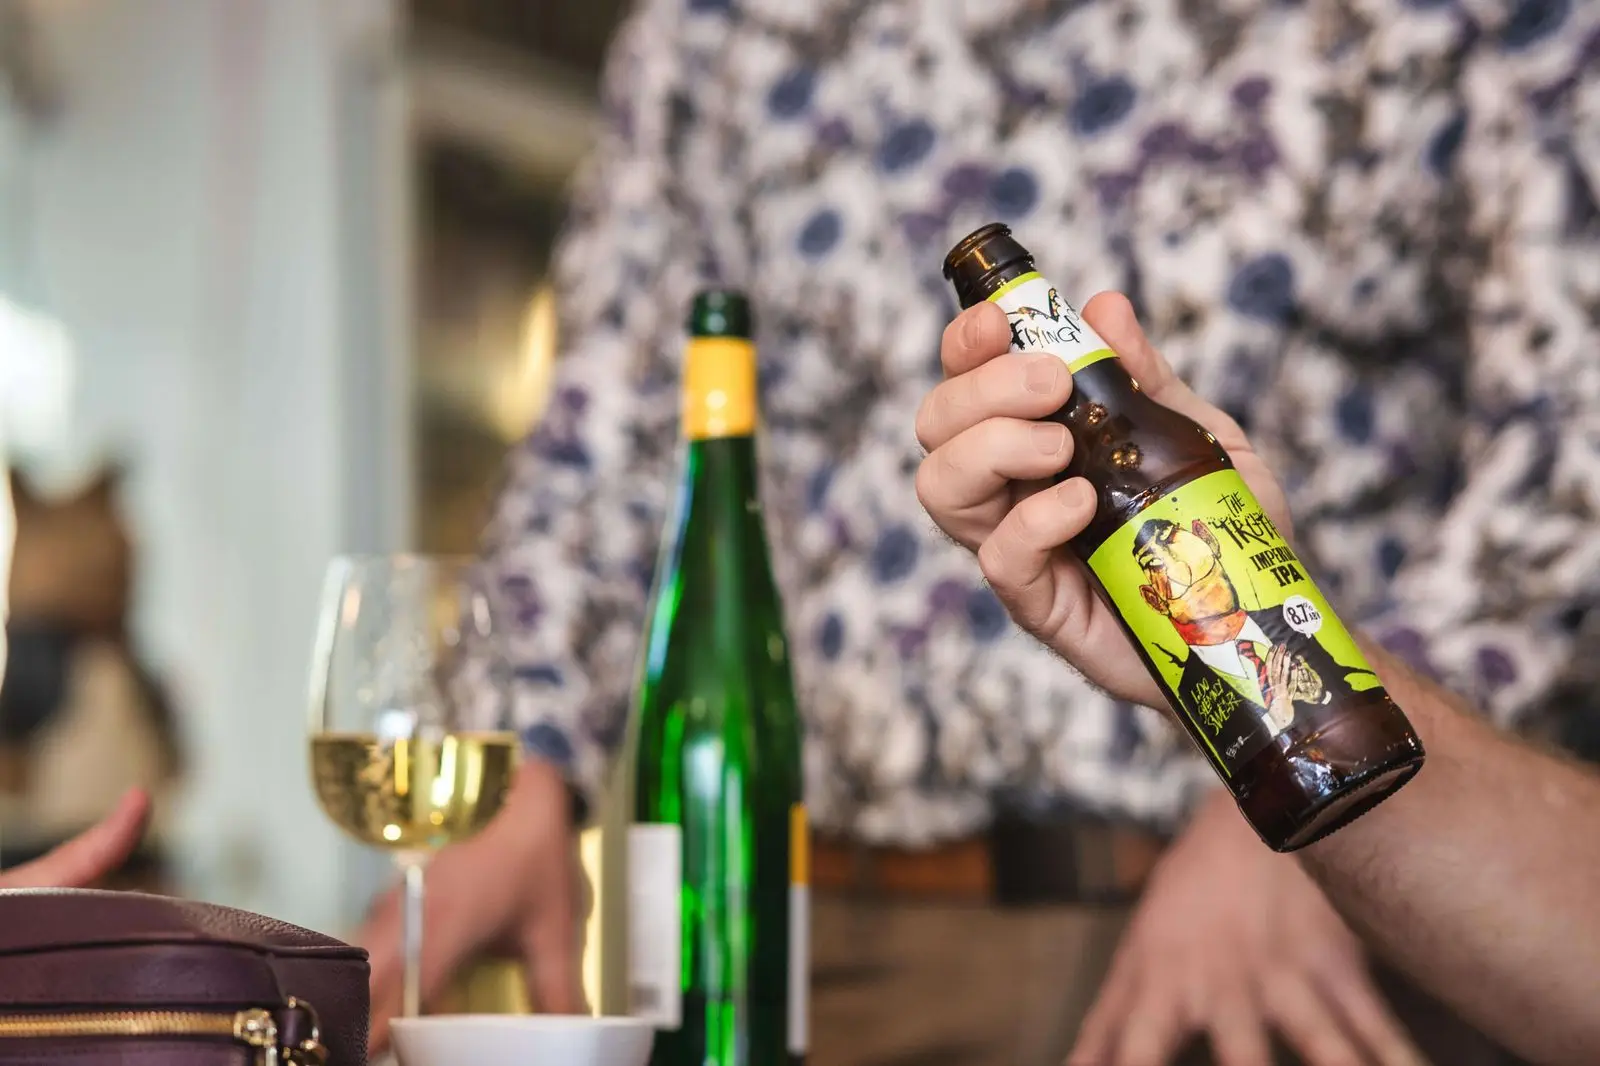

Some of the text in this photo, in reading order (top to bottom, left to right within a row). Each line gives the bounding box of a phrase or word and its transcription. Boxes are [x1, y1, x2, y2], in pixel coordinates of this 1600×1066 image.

[1010, 318, 1080, 350] FLYING
[1217, 492, 1245, 517] THE
[1270, 563, 1305, 587] IPA
